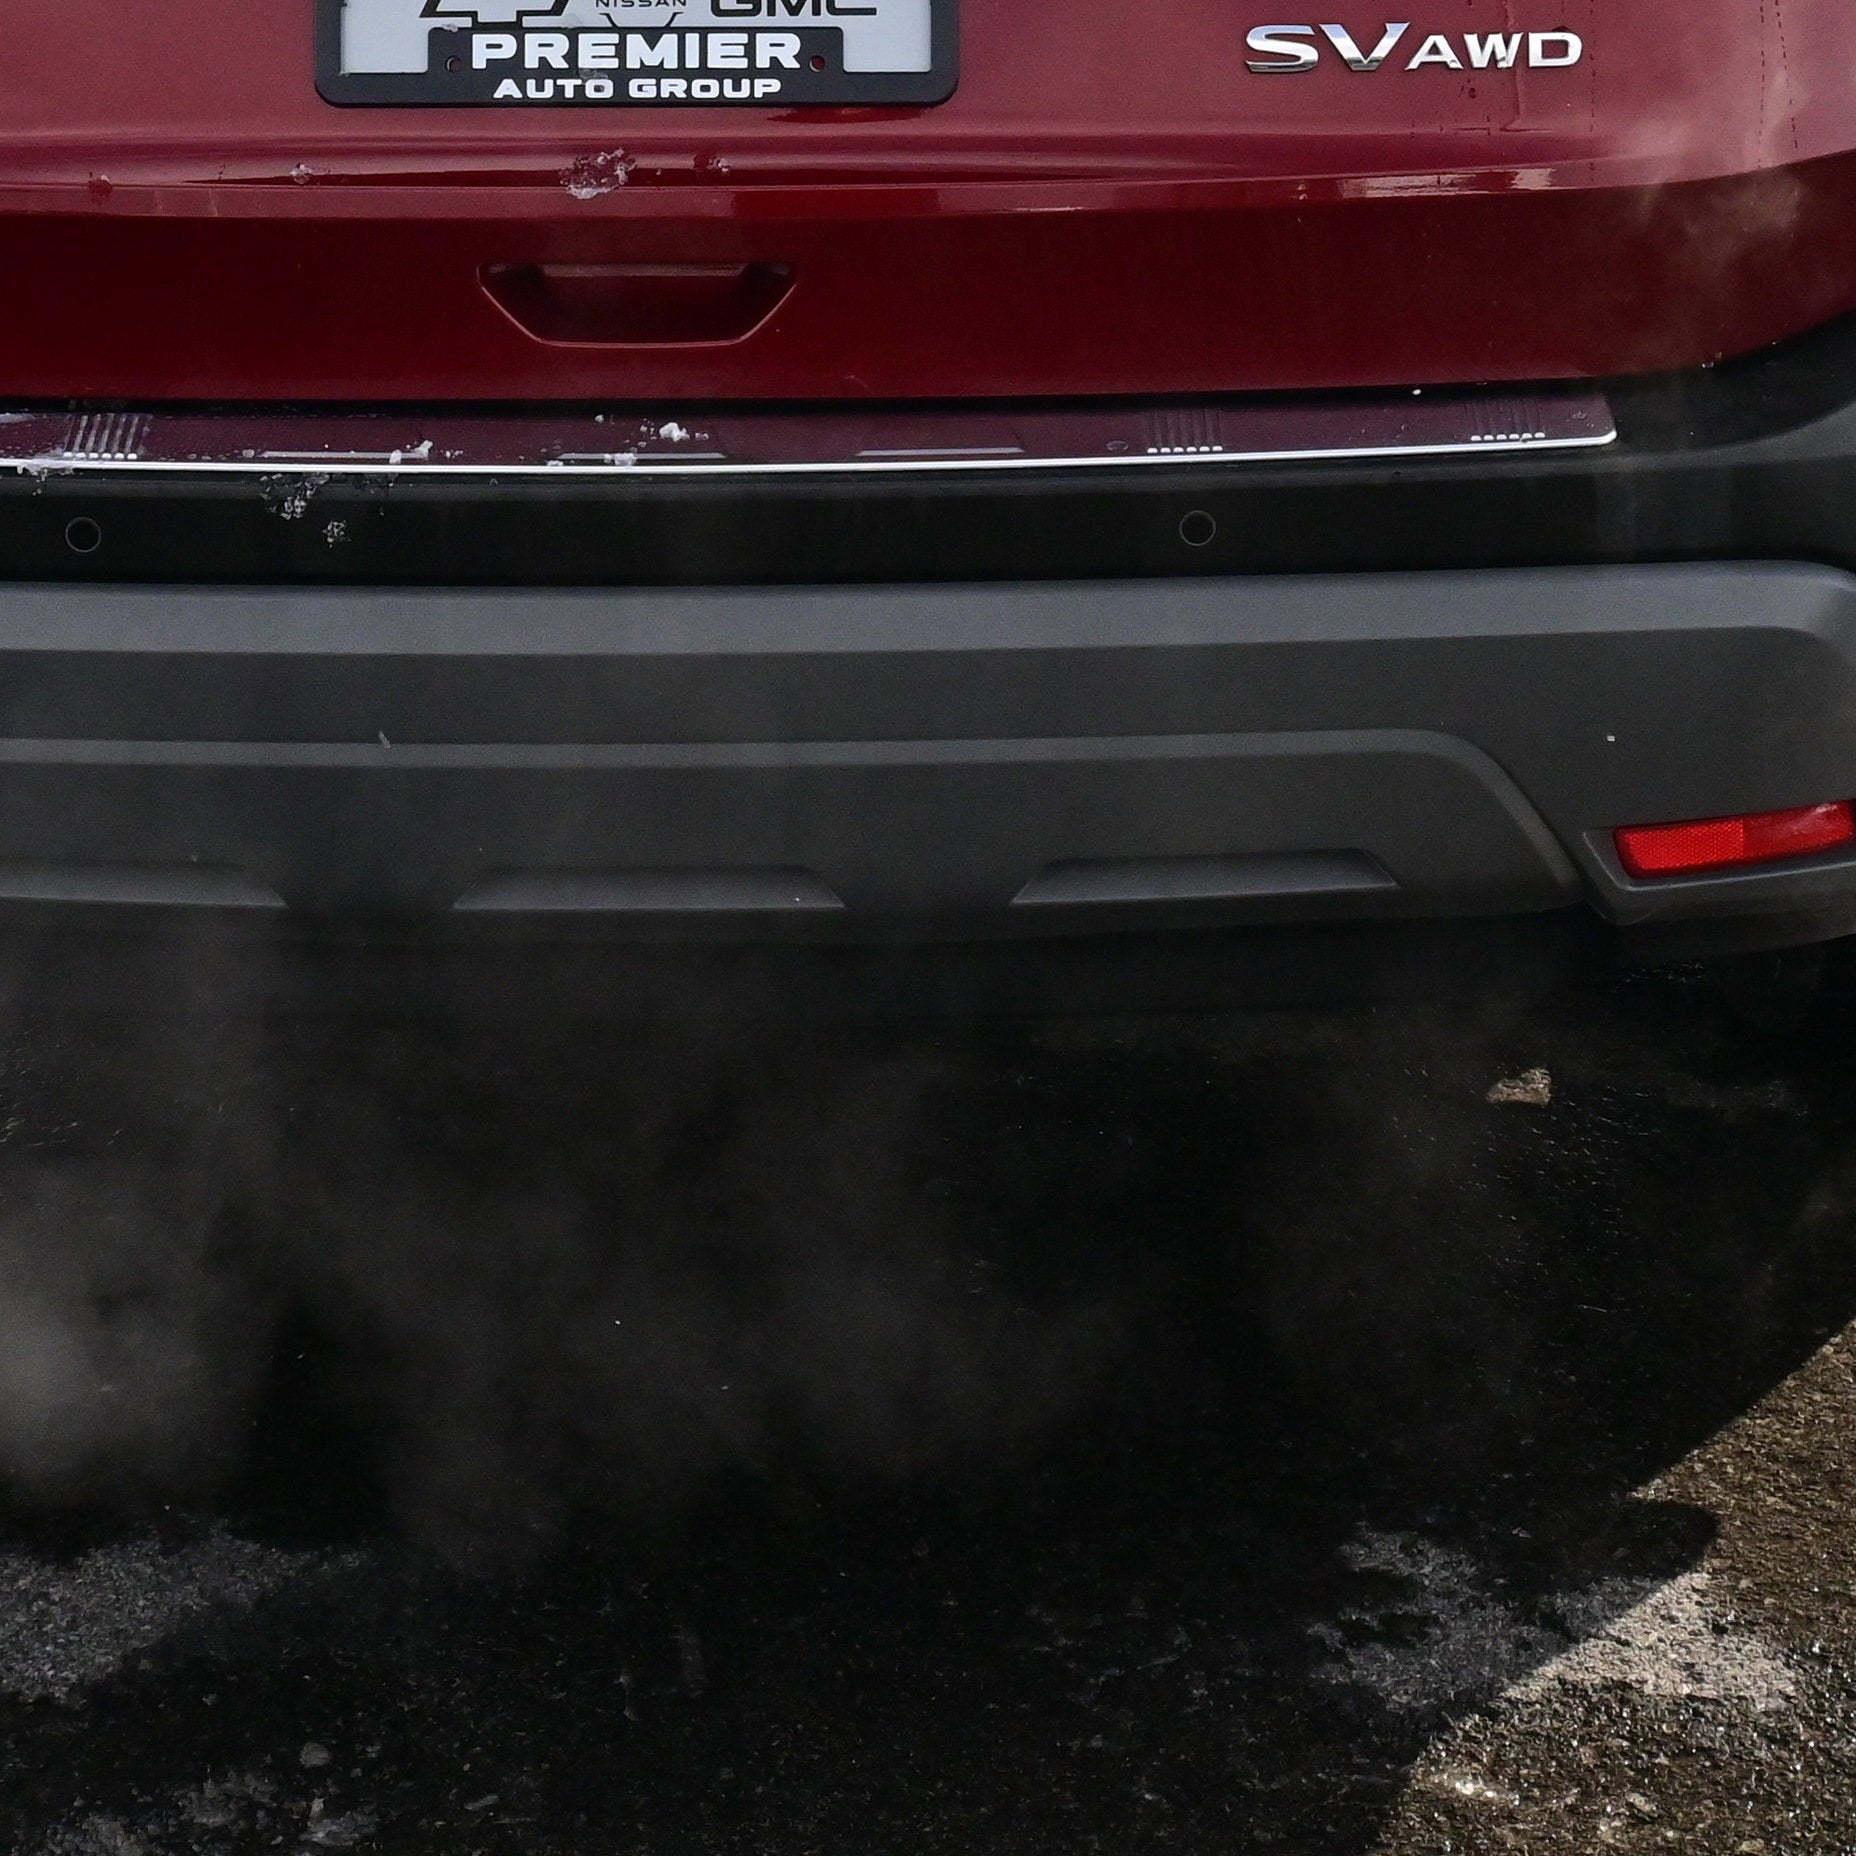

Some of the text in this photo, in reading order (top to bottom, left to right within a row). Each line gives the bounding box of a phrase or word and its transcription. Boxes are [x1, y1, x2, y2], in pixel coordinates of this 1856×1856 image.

[471, 32, 802, 71] PREMIER
[492, 78, 783, 100] AUTO GROUP
